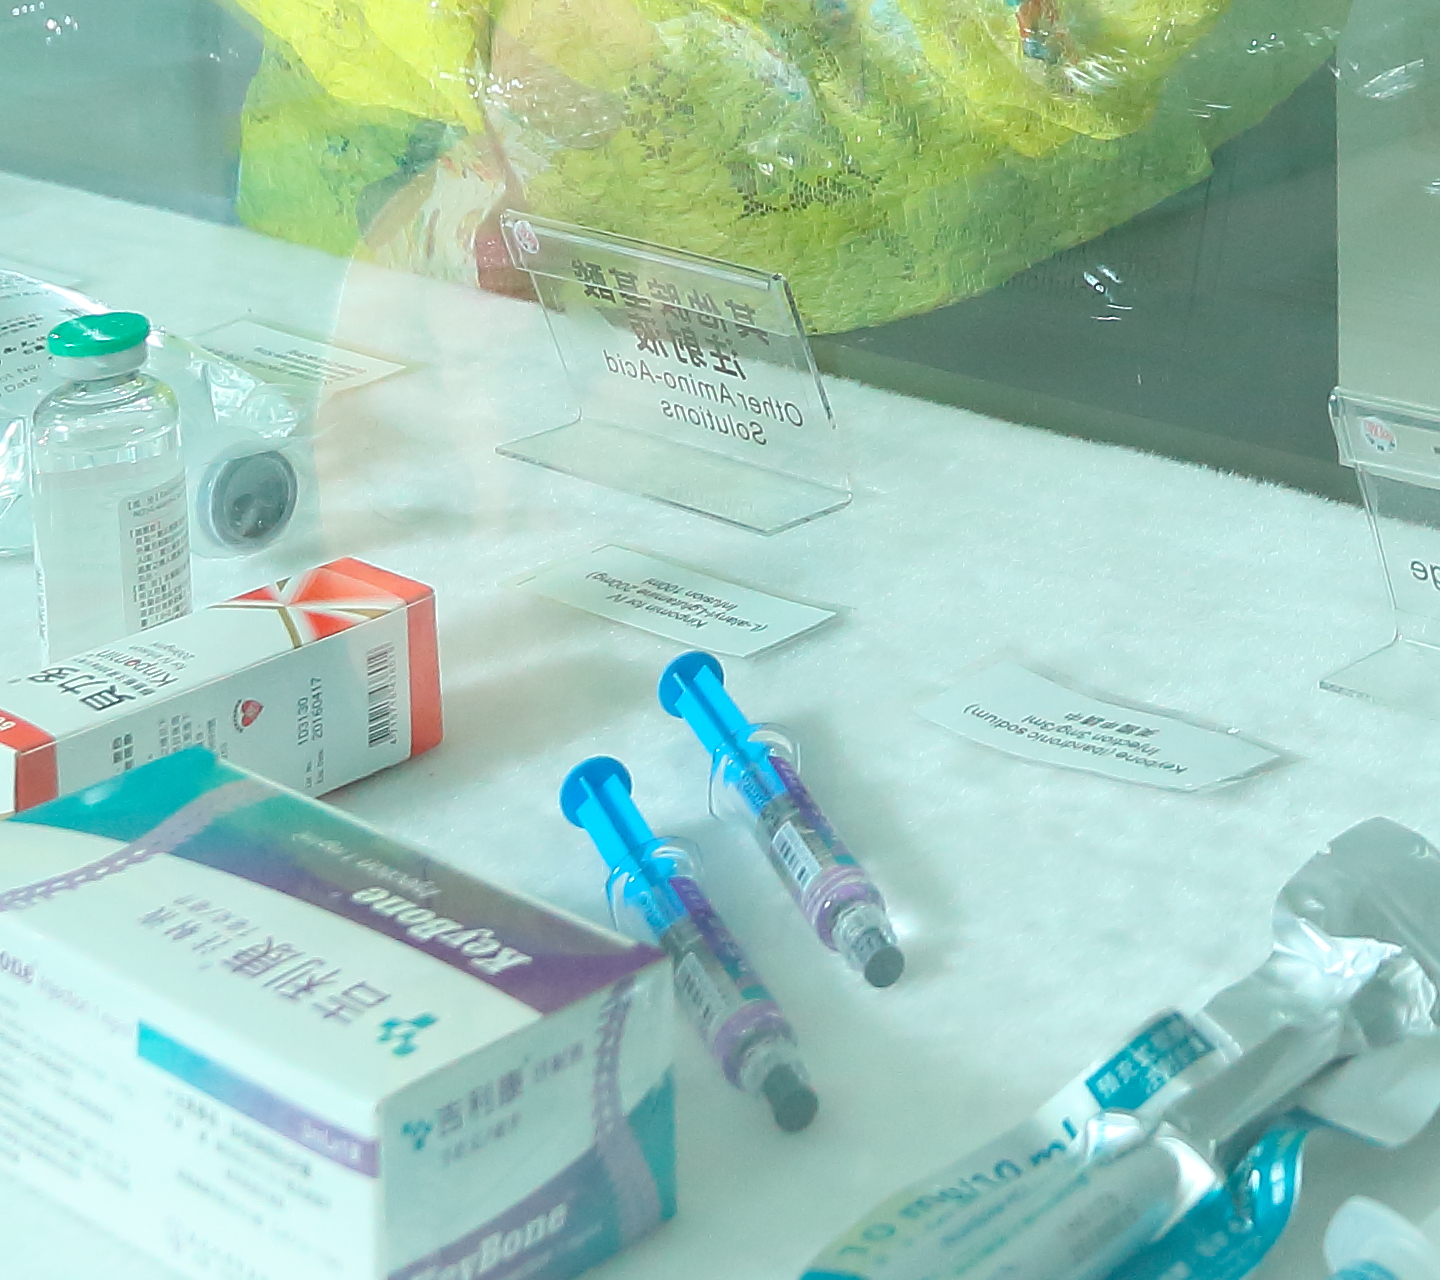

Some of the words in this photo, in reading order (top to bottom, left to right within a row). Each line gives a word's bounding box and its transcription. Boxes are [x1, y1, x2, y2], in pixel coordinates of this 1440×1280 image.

[586, 571, 638, 592] 200mg)
[642, 577, 684, 595] 100ml
[607, 593, 627, 603] IV
[627, 599, 645, 609] for
[685, 590, 738, 611] Infusion
[646, 604, 708, 629] Kinpomin
[96, 649, 179, 687] Kinpomin
[27, 666, 137, 711] 貝力多
[310, 677, 323, 741] 20160417
[963, 703, 1028, 735] sodium)
[1021, 714, 1091, 740] 3mg/3ml
[1091, 731, 1160, 755] Injection
[1115, 751, 1188, 774] Keybone
[349, 886, 534, 976] KeyBone
[221, 935, 391, 1025] 吉利康
